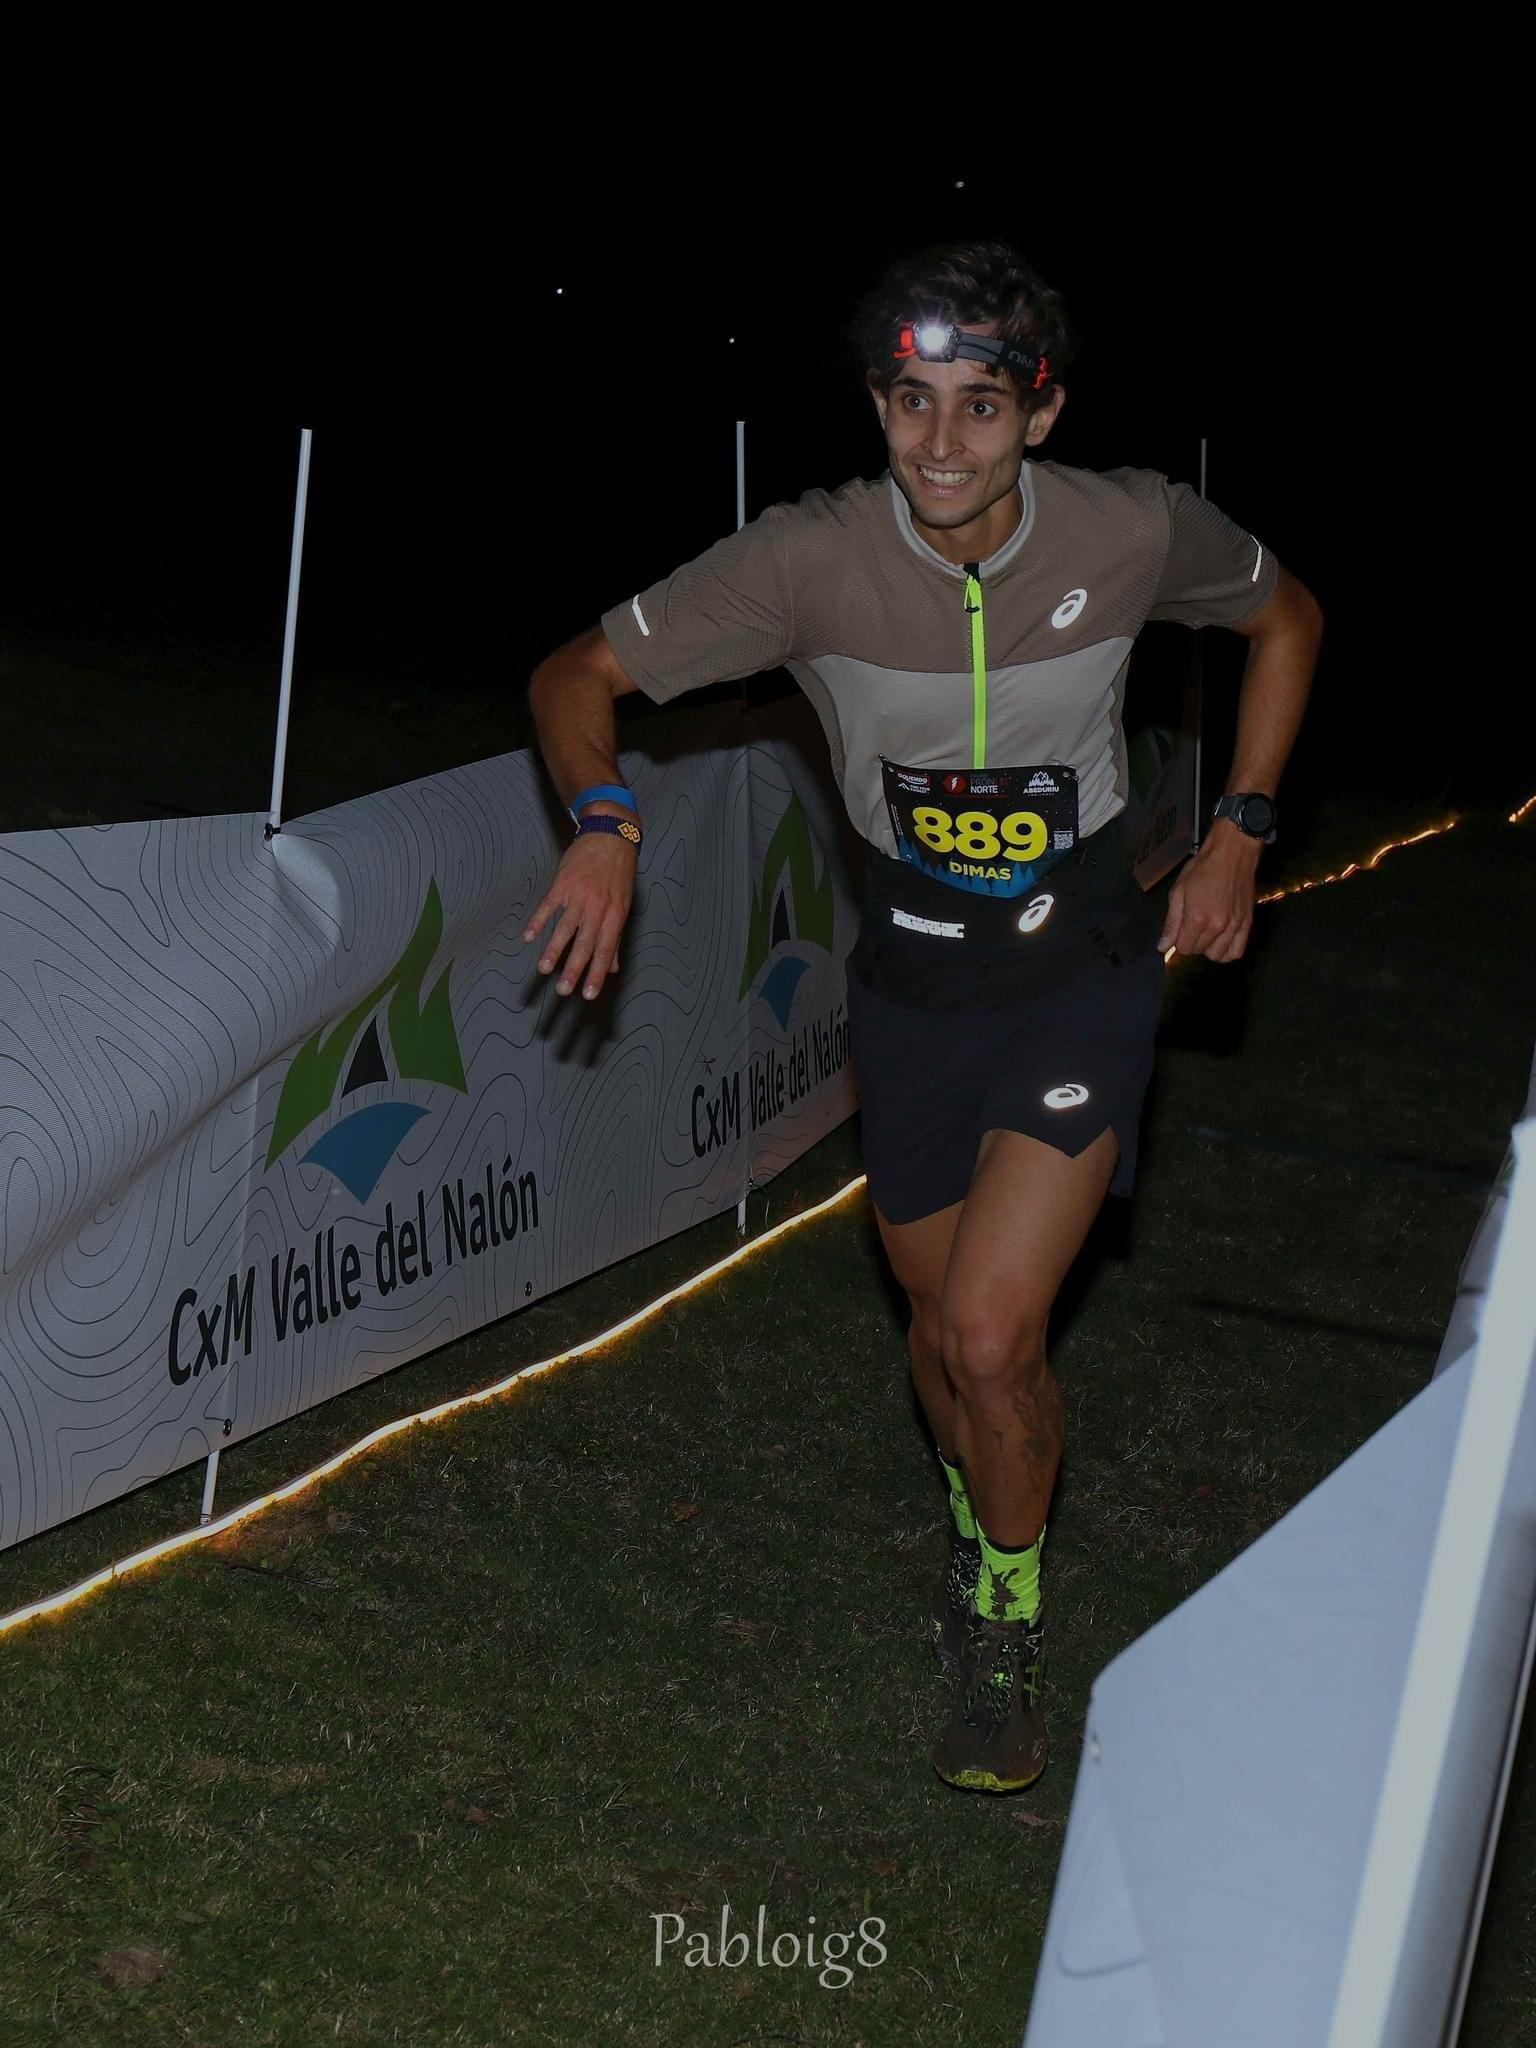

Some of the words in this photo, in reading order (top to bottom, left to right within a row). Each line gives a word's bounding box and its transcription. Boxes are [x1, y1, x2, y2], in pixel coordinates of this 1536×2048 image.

[970, 785, 999, 794] NORTE
[911, 806, 1049, 862] 889
[948, 861, 1012, 881] DIMAS
[691, 1071, 741, 1158] CxM
[748, 1047, 785, 1131] Valle
[789, 1026, 811, 1104] del
[813, 1004, 852, 1086] Nalón
[168, 1266, 256, 1386] CxM
[271, 1226, 362, 1342] Valle
[375, 1190, 433, 1296] del
[441, 1153, 540, 1266] Nalón
